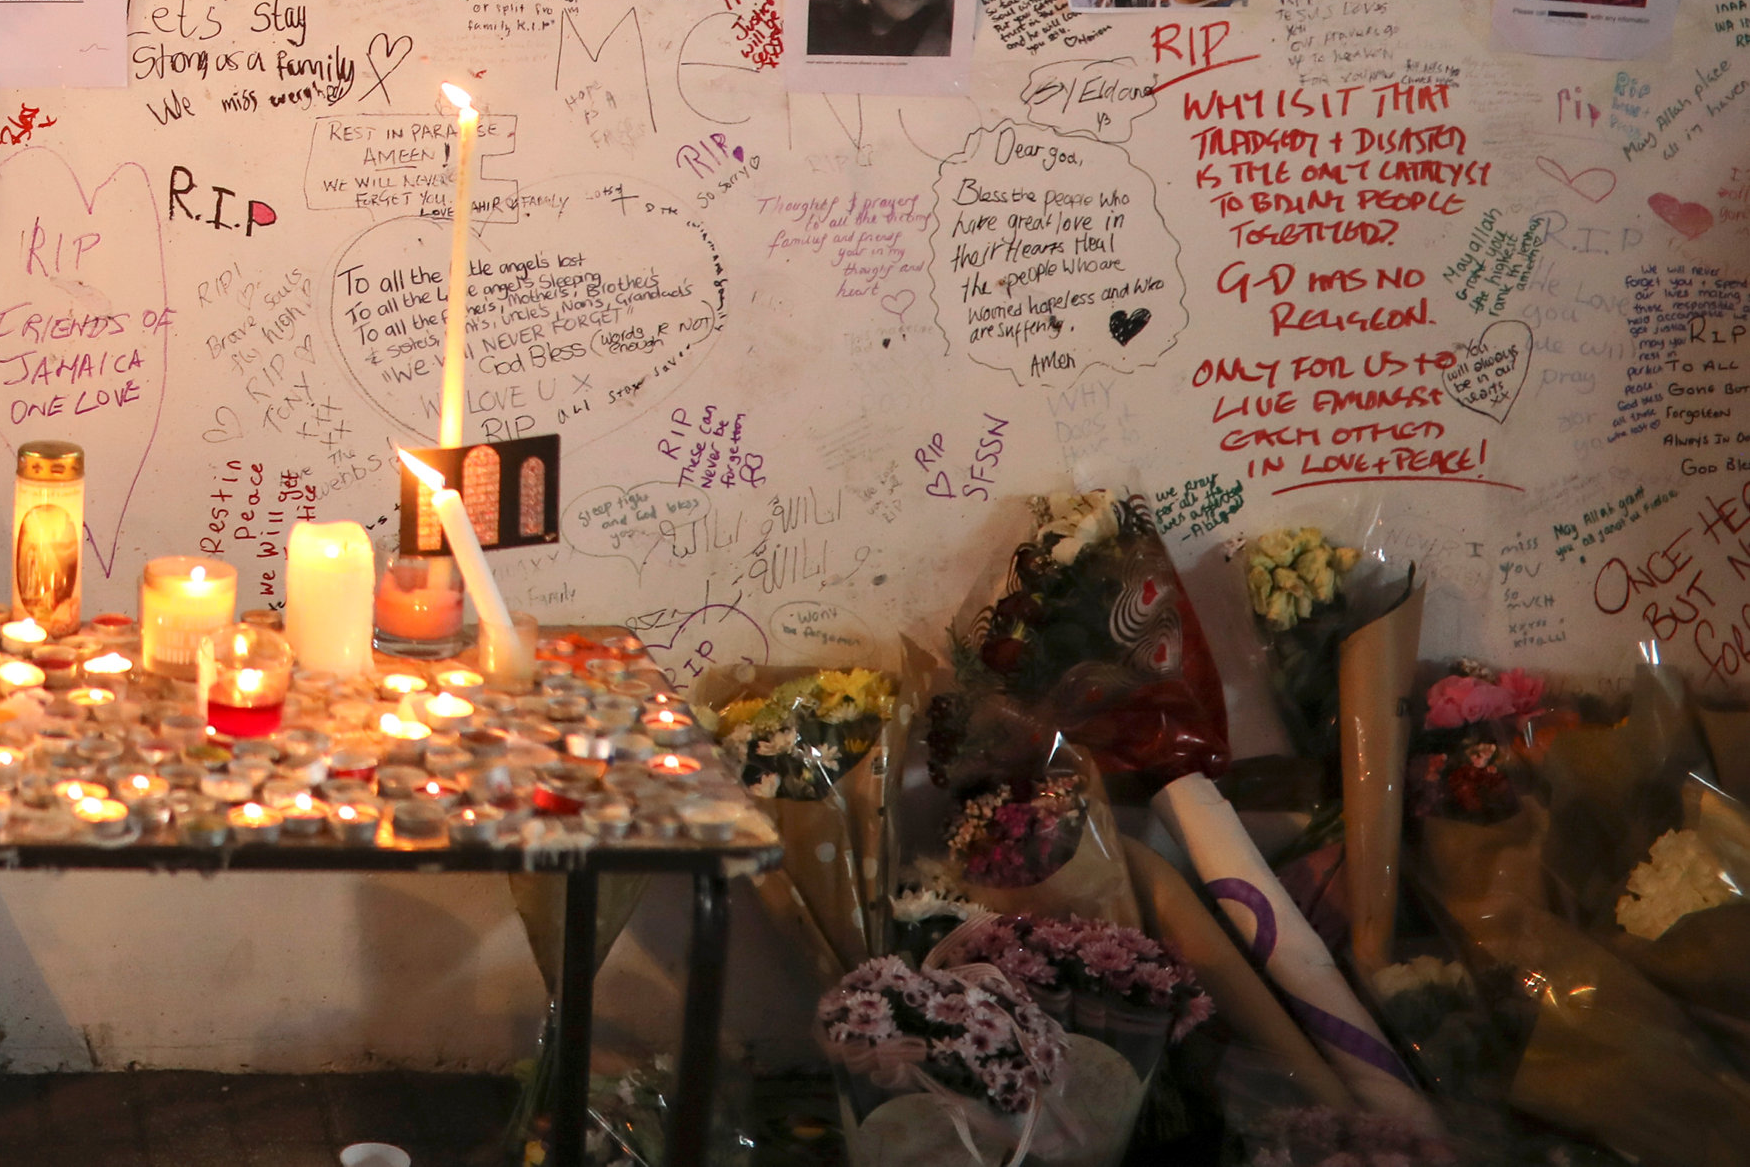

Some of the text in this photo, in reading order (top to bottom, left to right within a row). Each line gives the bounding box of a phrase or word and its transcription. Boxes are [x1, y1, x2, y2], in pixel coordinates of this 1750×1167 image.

[1151, 21, 1231, 67] RIP
[169, 165, 277, 236] R.I.P
[27, 216, 100, 277] RIP
[143, 307, 177, 335] OF
[0, 349, 144, 385] JAMAICA
[11, 380, 139, 424] ONE LOVE
